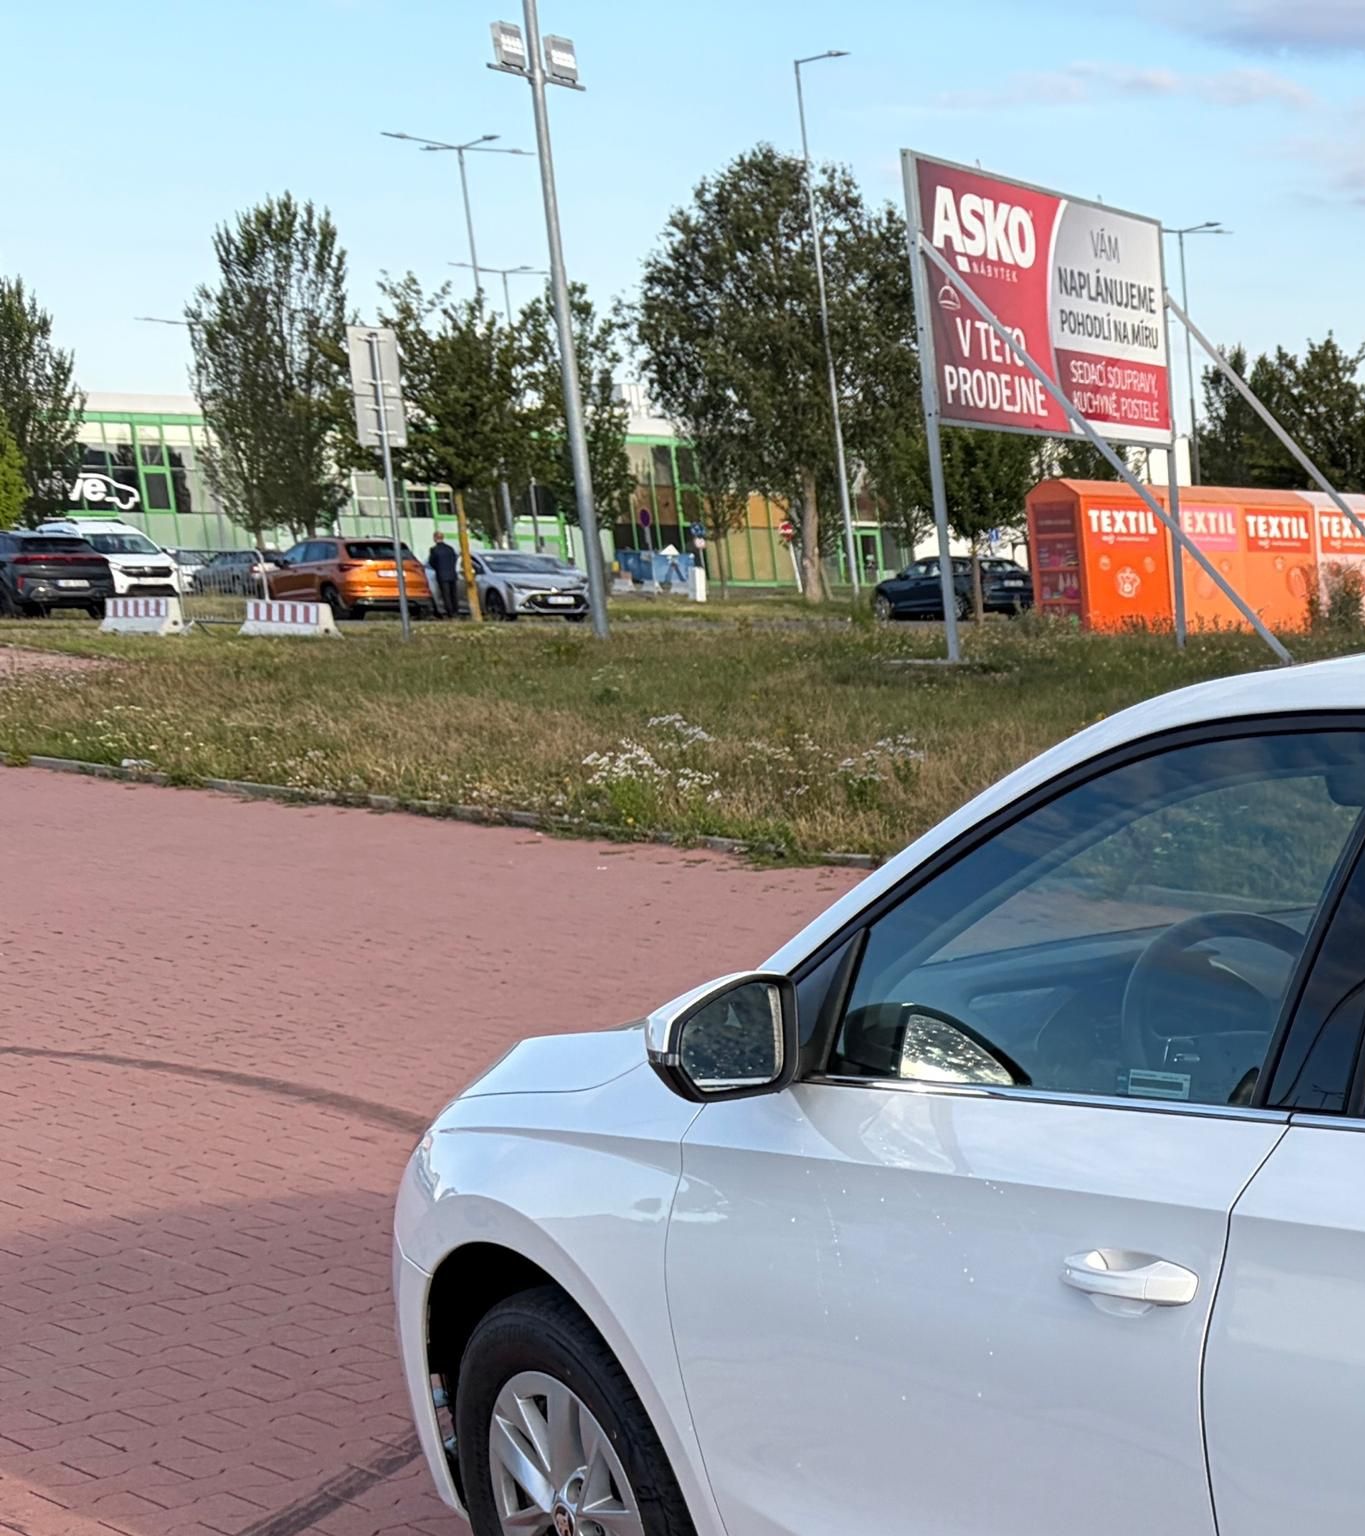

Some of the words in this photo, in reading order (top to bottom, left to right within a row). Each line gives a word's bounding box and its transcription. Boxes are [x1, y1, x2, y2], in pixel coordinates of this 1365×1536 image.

[932, 185, 1036, 269] ASKO
[1090, 228, 1121, 264] VÁM
[972, 261, 1019, 283] NÁBYTEK
[1058, 266, 1157, 314] NAPLÁNUJEME
[955, 316, 972, 358] V
[1060, 308, 1112, 342] POHODLÍ
[1112, 319, 1131, 345] NA
[1131, 320, 1159, 350] MÍRU
[943, 364, 1049, 417] PRODEJNE
[1069, 359, 1106, 387] SEDACÍ
[1106, 366, 1159, 399] SOUPRAVY,
[1120, 397, 1161, 423] POSTELE
[1088, 509, 1158, 535] TEXTIL
[1183, 510, 1237, 535] EXTIL
[1245, 515, 1309, 540] TEXTIL
